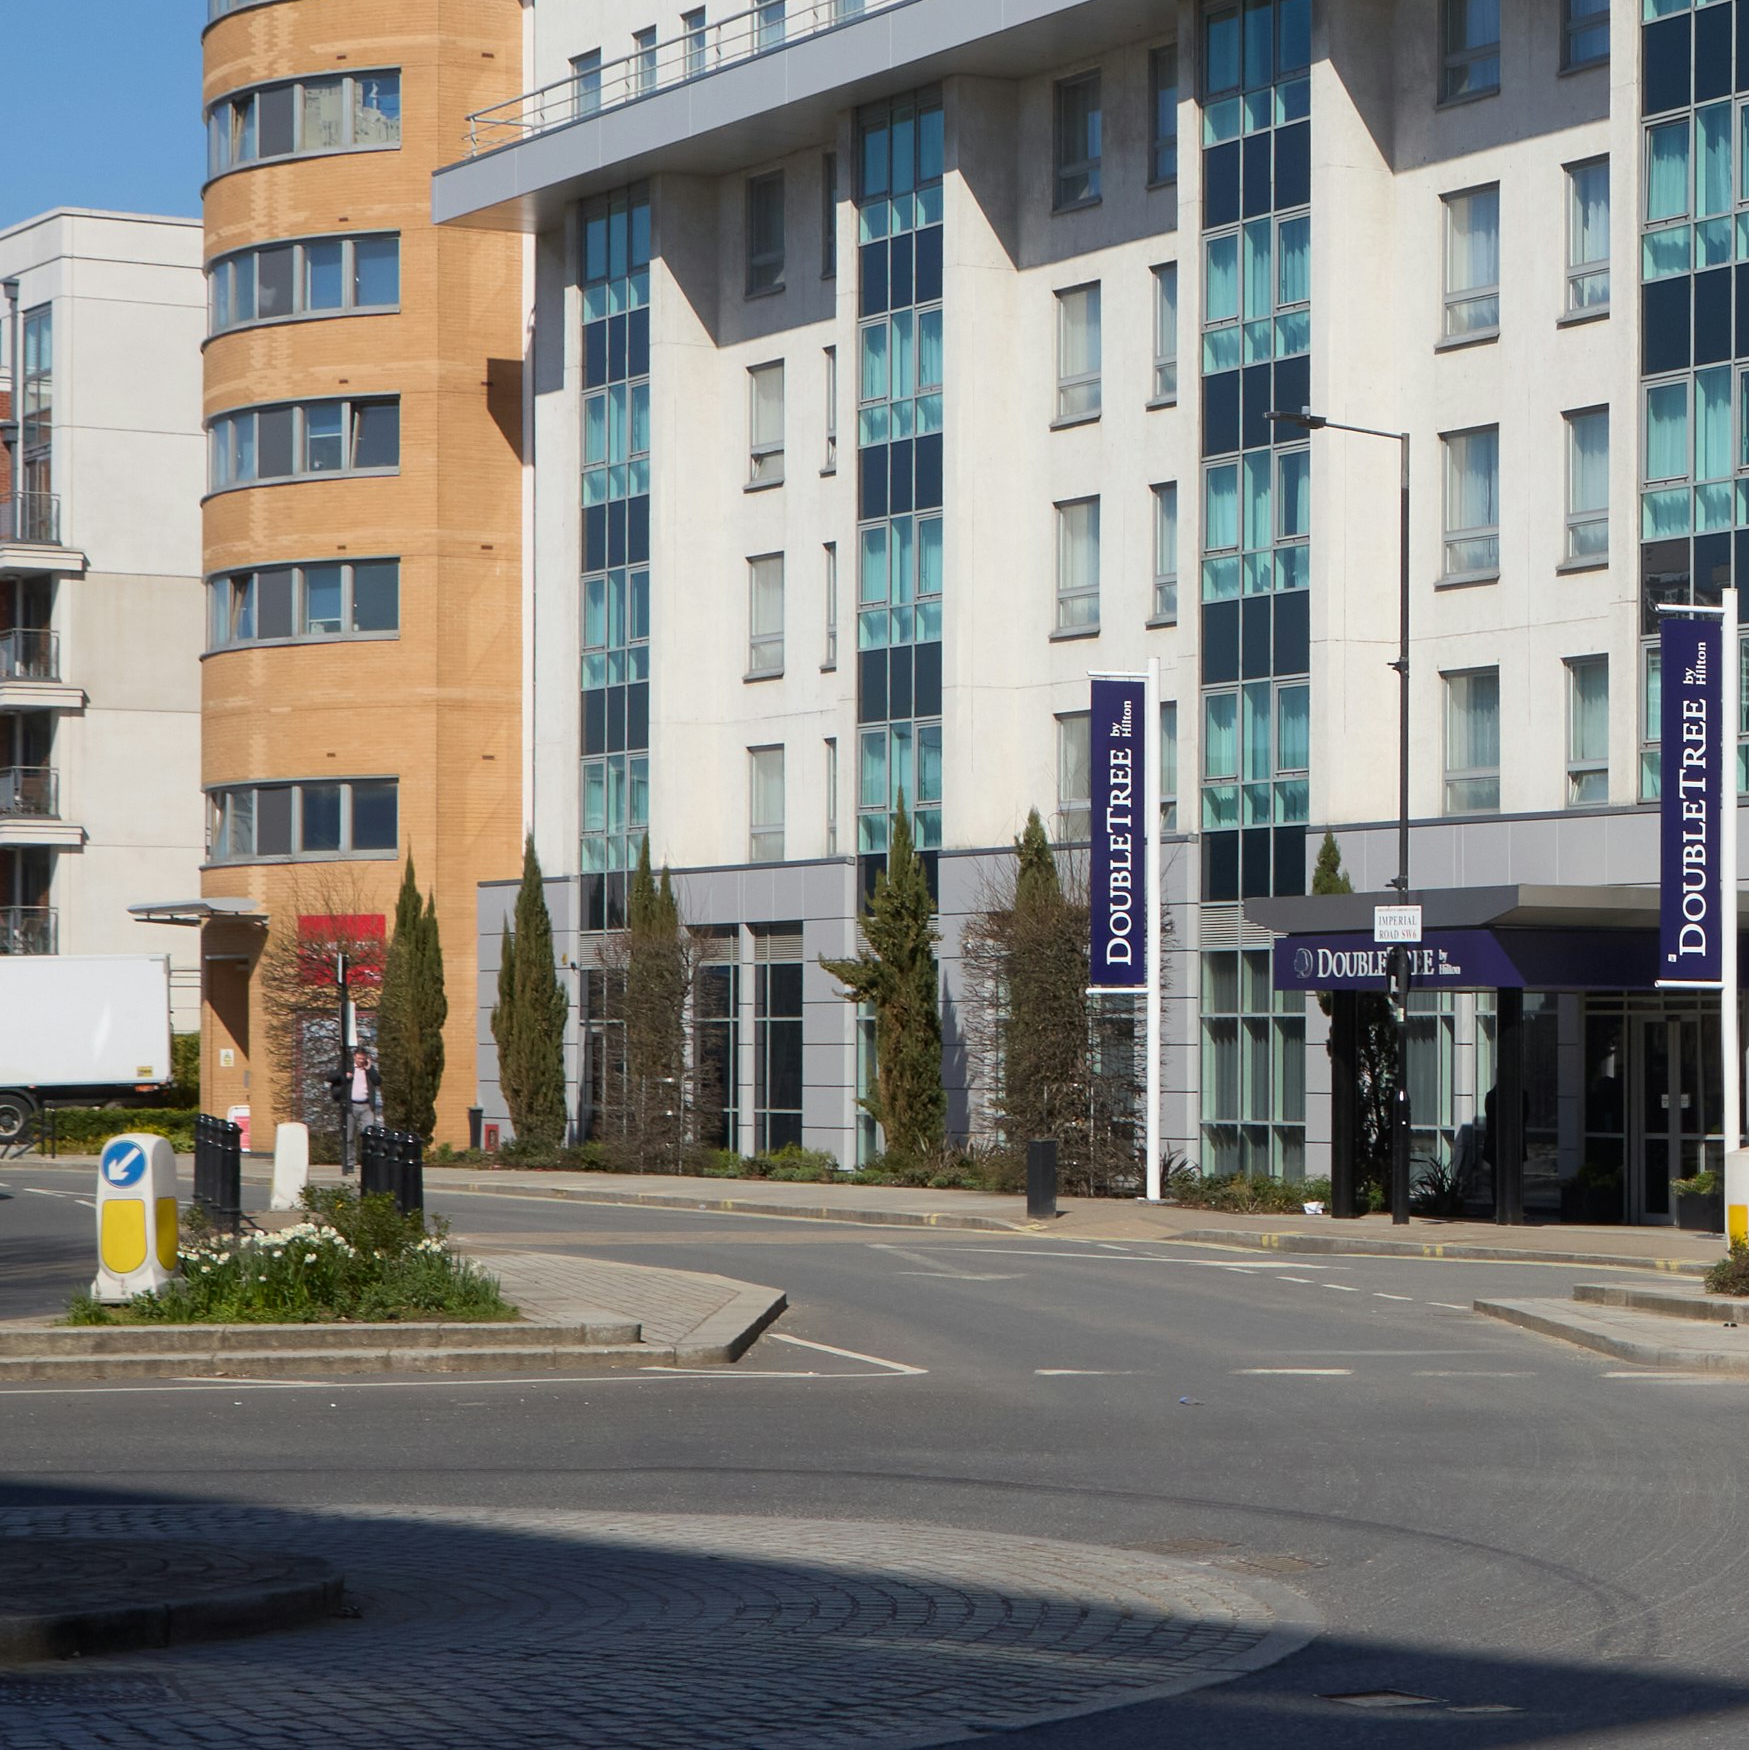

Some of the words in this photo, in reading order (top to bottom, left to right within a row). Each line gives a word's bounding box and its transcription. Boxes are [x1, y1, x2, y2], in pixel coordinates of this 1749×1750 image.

[1683, 667, 1696, 685] by
[1695, 641, 1707, 685] Hilton
[1109, 721, 1121, 737] by
[1121, 700, 1132, 737] Hilton
[1679, 698, 1707, 957] DOUBLETREE
[1106, 748, 1132, 966] DOUBLETREE
[1379, 915, 1417, 926] IMPERIAL
[1379, 930, 1400, 940] ROAD
[1402, 929, 1417, 939] SW6
[1317, 947, 1435, 978] DOUBLEEE
